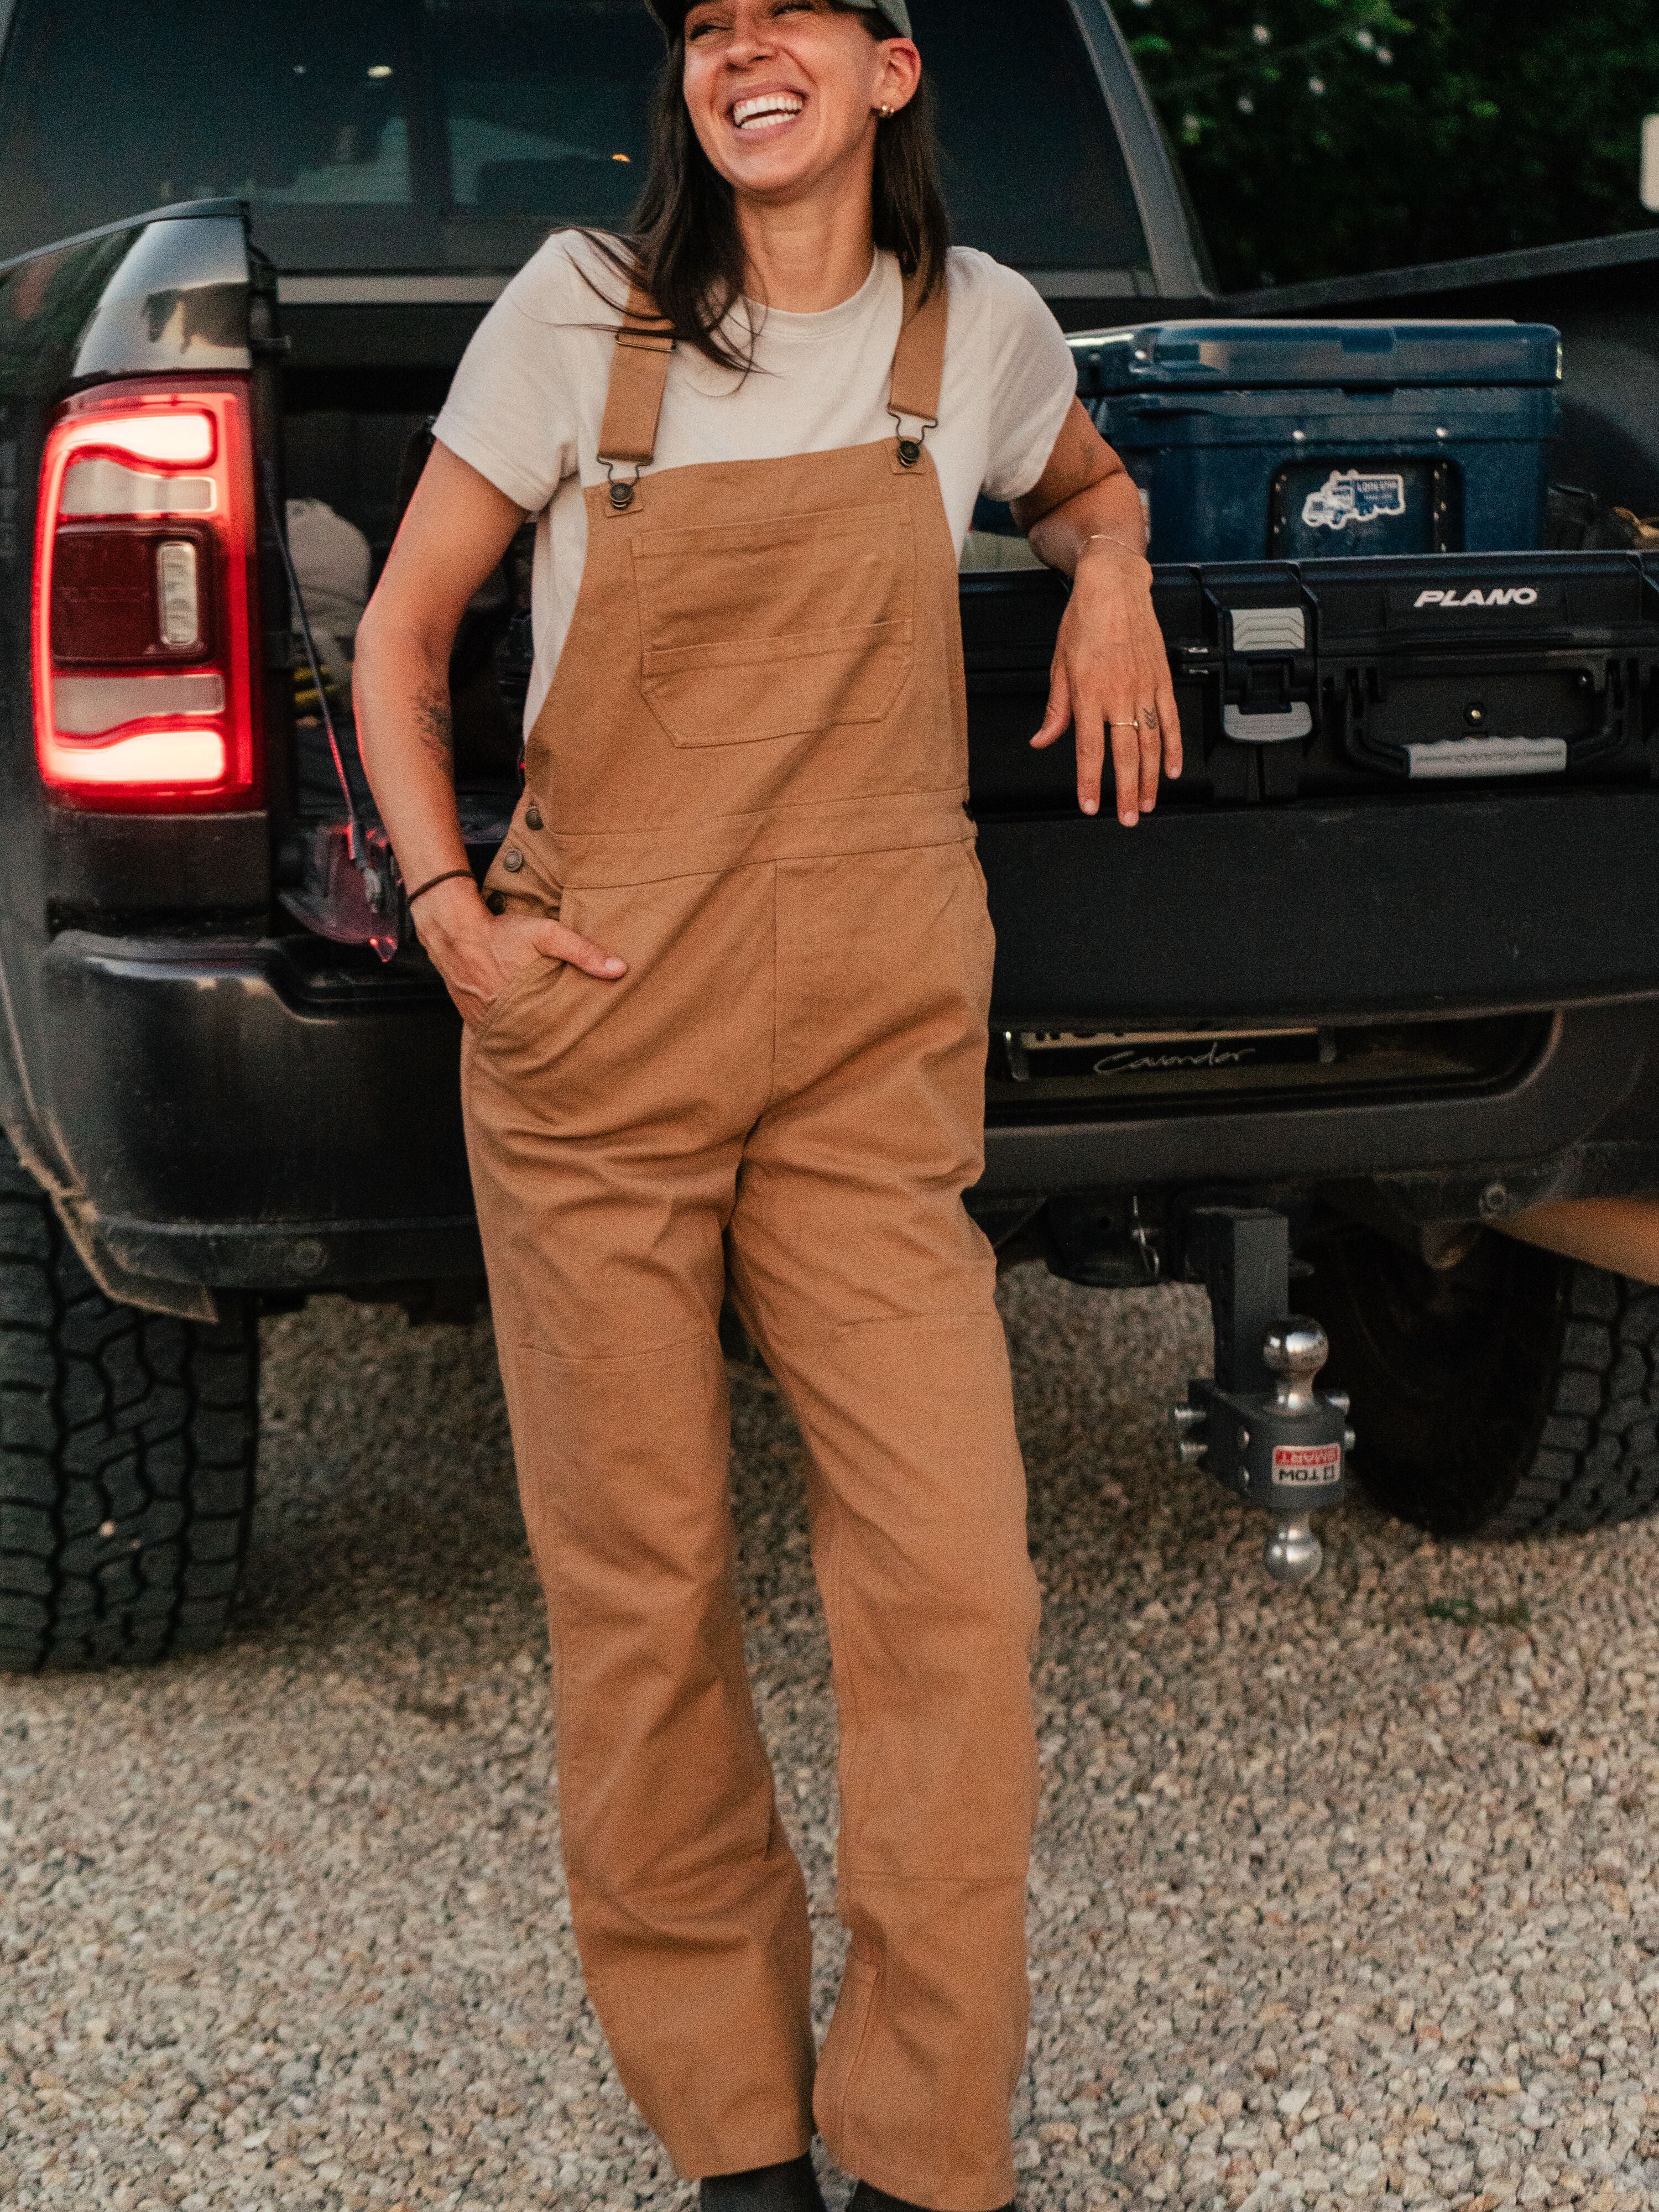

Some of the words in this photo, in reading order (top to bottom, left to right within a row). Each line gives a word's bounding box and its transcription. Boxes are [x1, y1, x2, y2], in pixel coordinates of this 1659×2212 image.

[1413, 587, 1538, 607] PLANO
[1277, 1448, 1337, 1464] SMART
[1279, 1469, 1319, 1481] TOW
